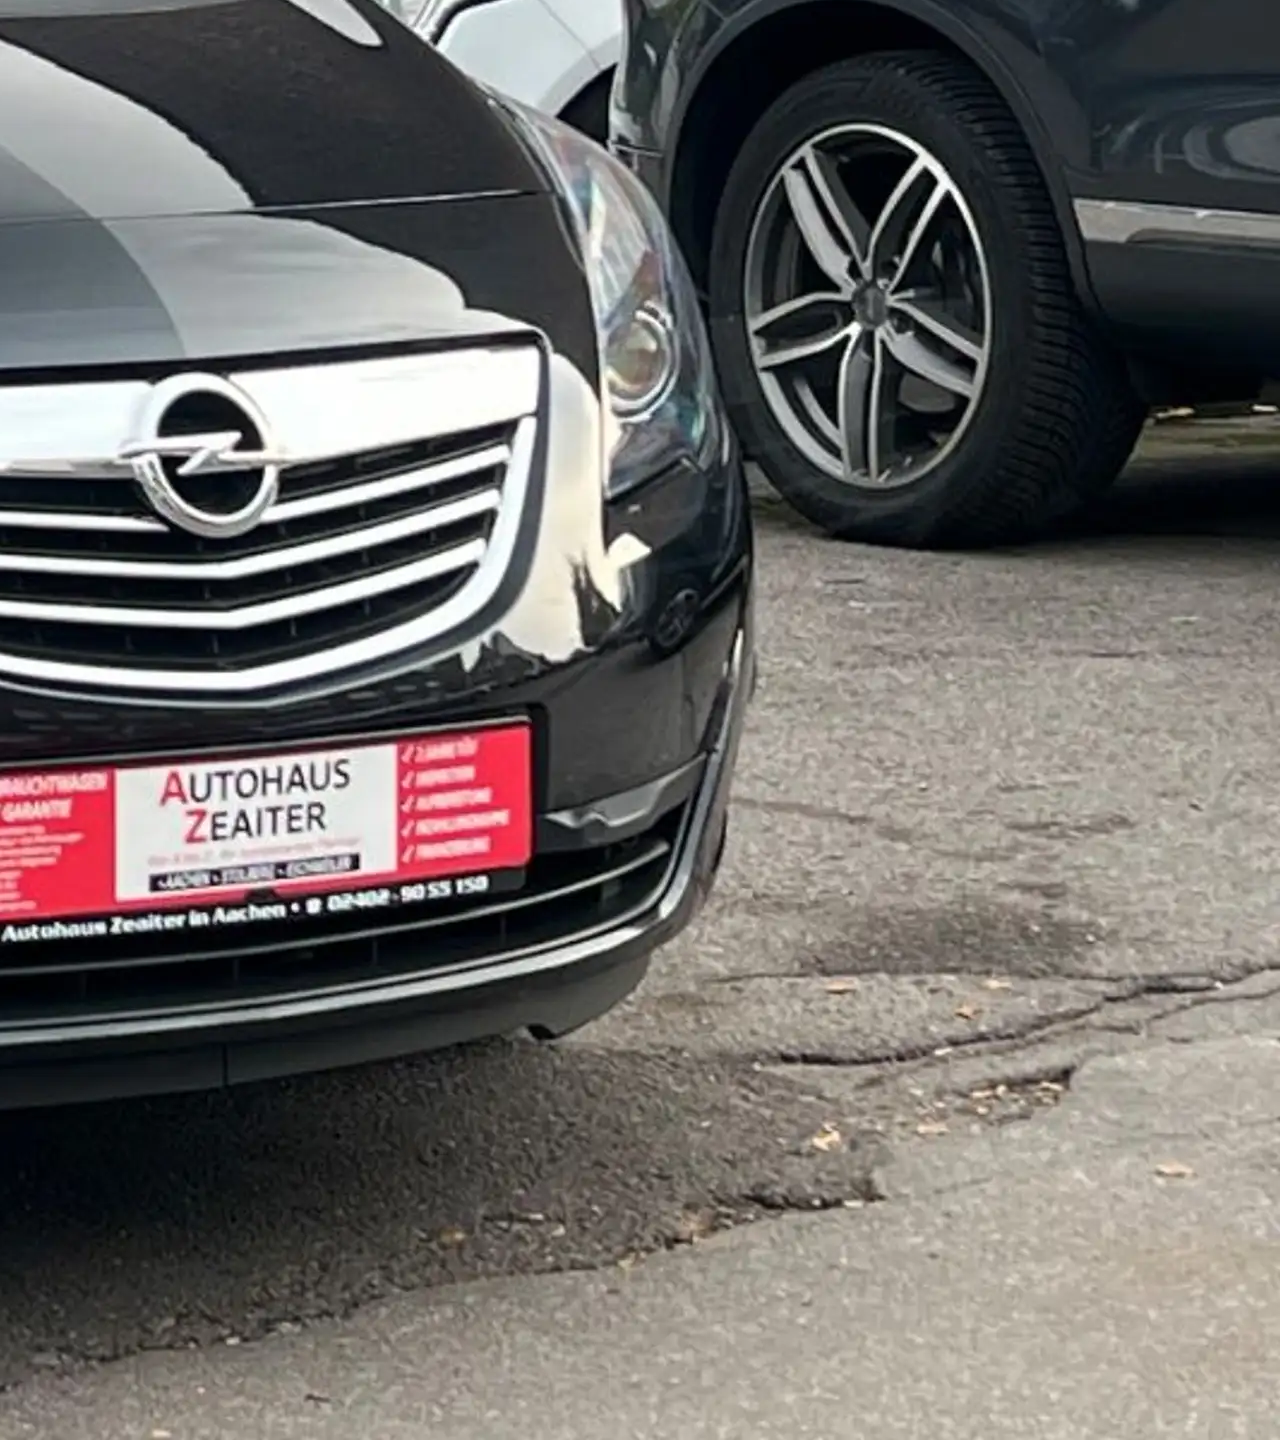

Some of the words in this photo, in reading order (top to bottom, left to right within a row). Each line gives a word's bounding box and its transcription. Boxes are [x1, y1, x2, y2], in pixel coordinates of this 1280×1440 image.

[160, 759, 350, 807] AUTOHAUS
[184, 801, 326, 843] ZEAITER
[1, 919, 107, 942] Autohaus
[109, 910, 186, 935] Zeaiter
[188, 908, 209, 926] in
[212, 902, 287, 926] Aachen
